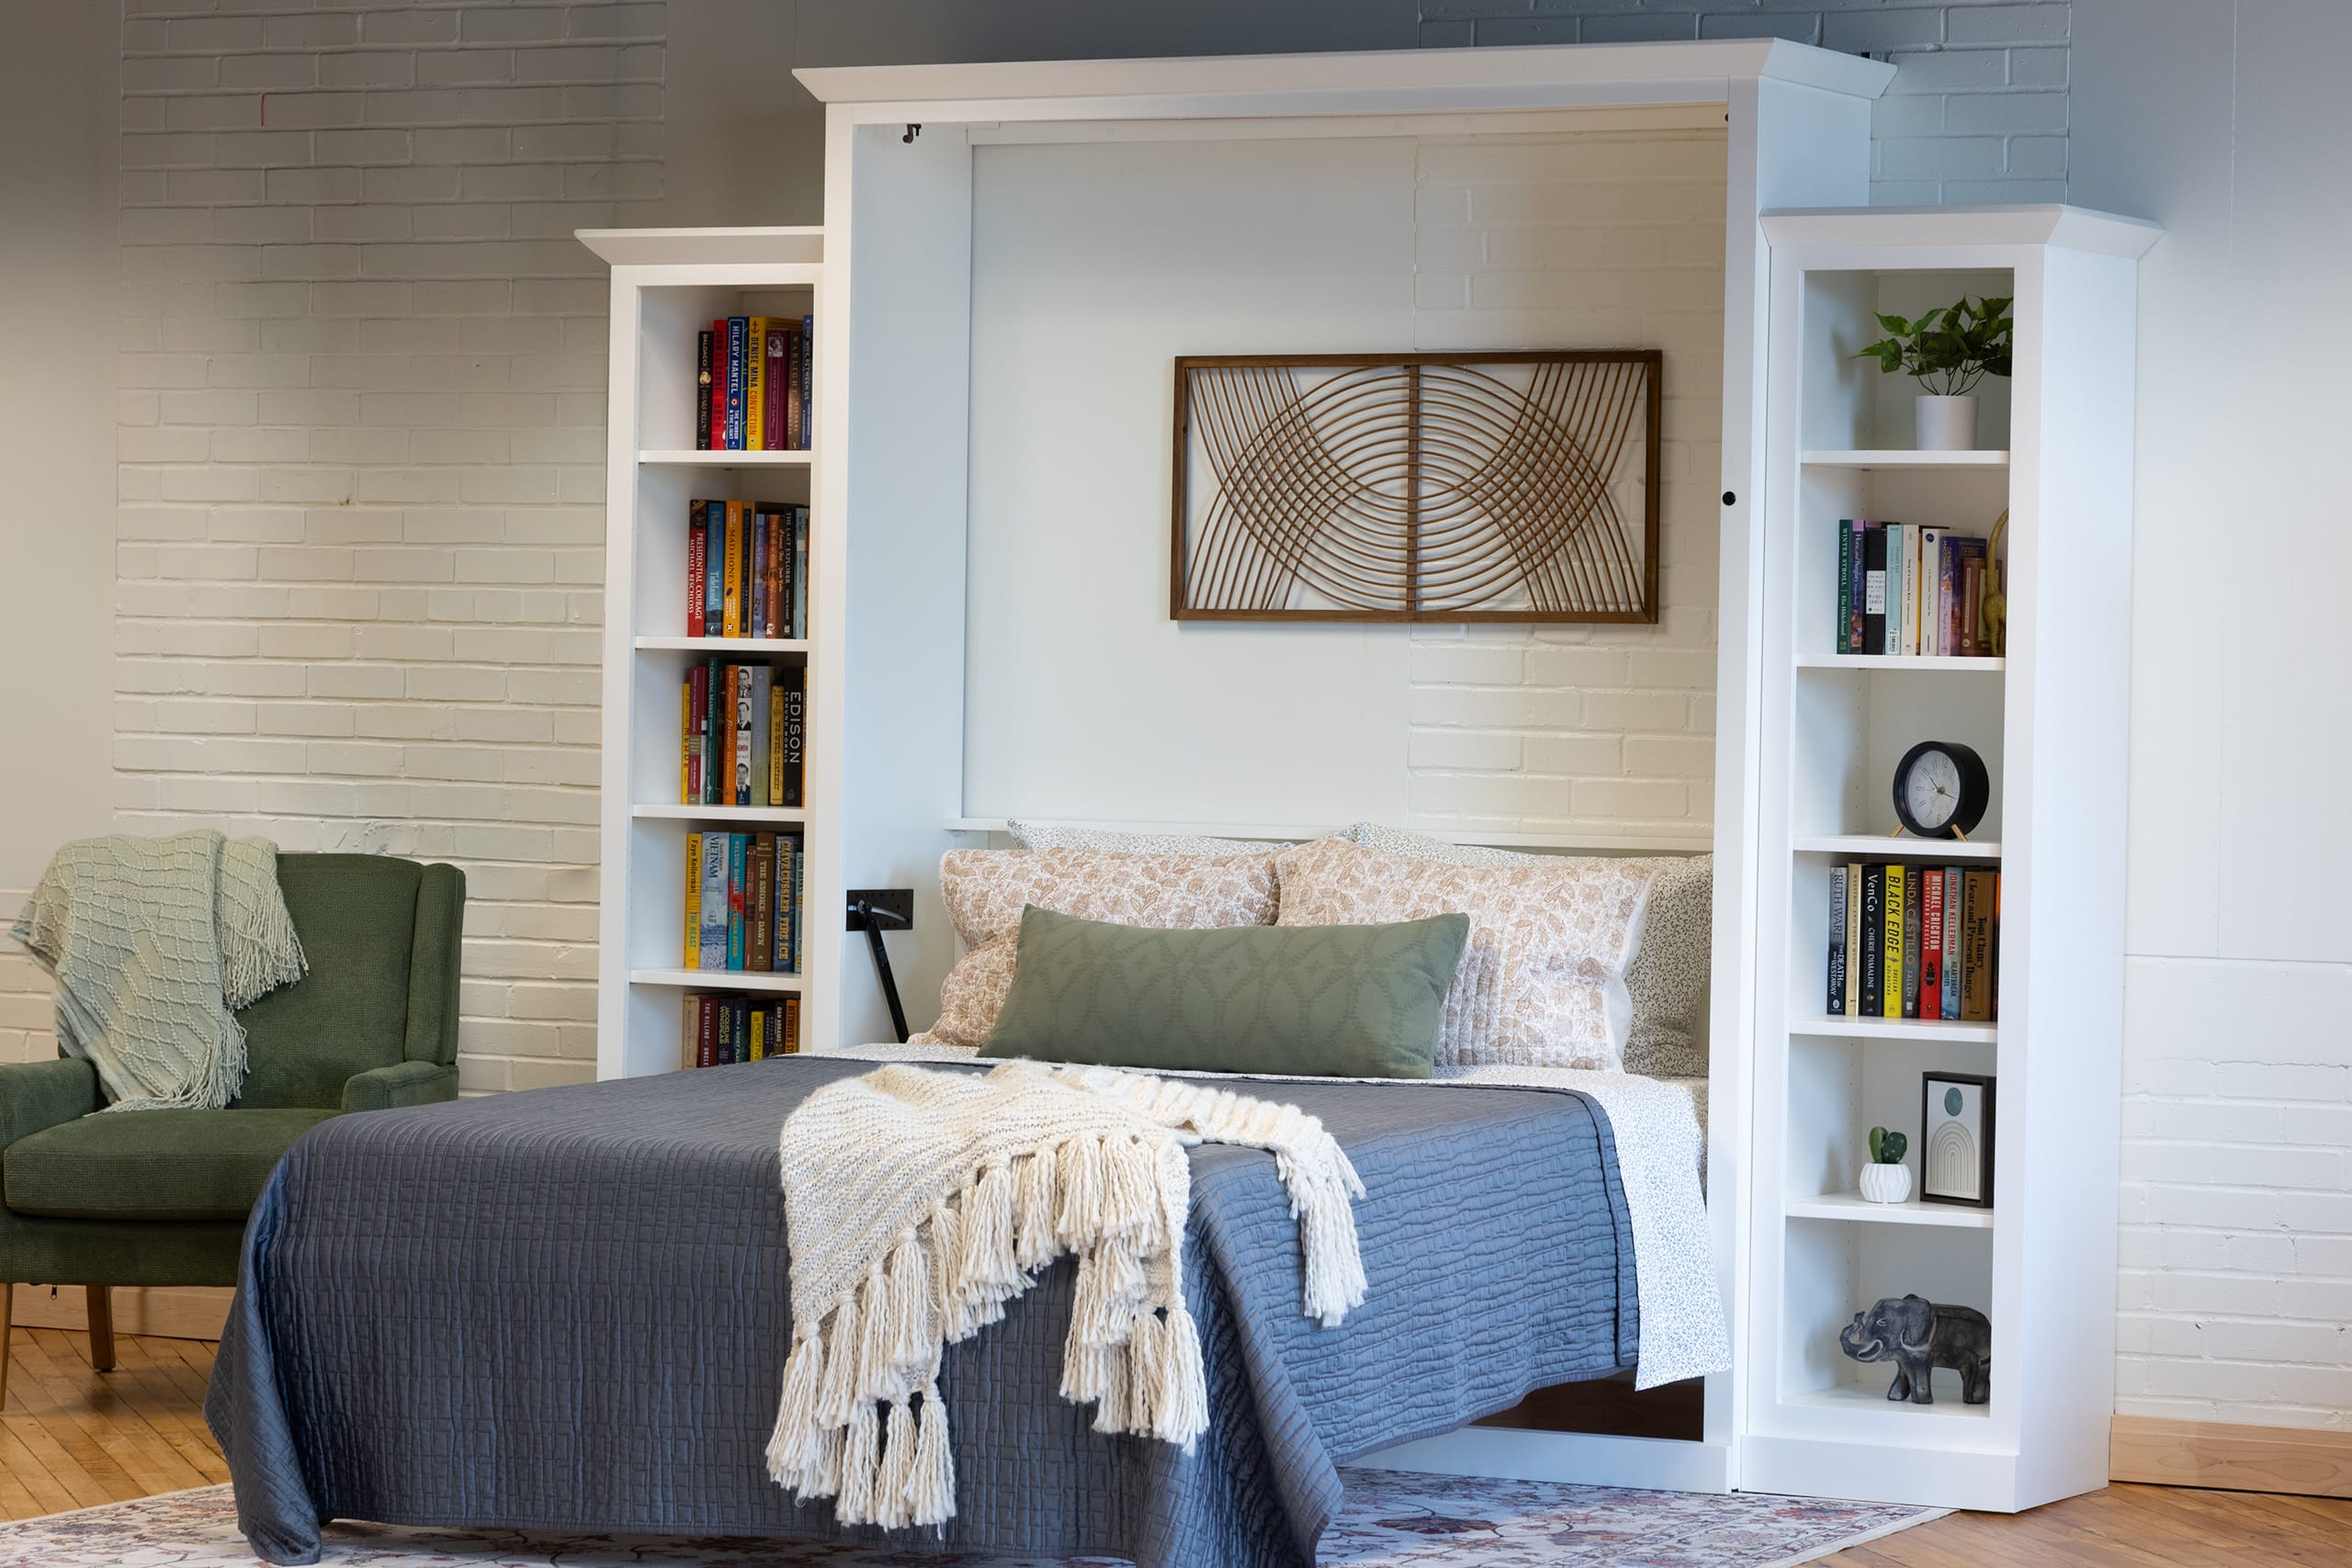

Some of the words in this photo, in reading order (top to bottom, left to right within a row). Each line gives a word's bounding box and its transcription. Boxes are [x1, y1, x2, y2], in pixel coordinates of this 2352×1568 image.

[731, 325, 740, 357] HILARY
[750, 336, 759, 364] DENISE
[730, 360, 739, 393] MANTEL
[750, 367, 759, 388] MINA
[749, 390, 757, 435] CONVICTION
[803, 391, 809, 400] US
[695, 533, 704, 582] PRESIDENTIAL
[695, 585, 703, 620] COURAGE
[709, 570, 719, 605] Tidelands
[789, 691, 801, 764] EDISON
[690, 840, 698, 856] Faye
[709, 836, 719, 878] VIETNAM
[781, 840, 791, 869] CLIVE
[690, 858, 698, 894] Kellerman
[779, 870, 790, 913] CUSSLER
[1834, 874, 1843, 904] RUTH
[1867, 874, 1878, 911] VenCo
[1906, 871, 1917, 906] LINDA
[1931, 876, 1941, 909] MICHAEL
[1948, 873, 1957, 909] JONATHAN
[1969, 878, 1977, 904] Clear
[1887, 876, 1900, 916] BLACK
[779, 917, 789, 941] FIRE
[1832, 908, 1843, 939] WARE
[1867, 928, 1875, 952] CHERIE
[1887, 920, 1900, 953] EDGE
[1905, 908, 1916, 964] CASTILLO
[1929, 911, 1940, 950] CRICHTON
[1948, 911, 1957, 955] KELLERMAN
[1977, 917, 1987, 935] Tom
[779, 942, 788, 960] ICE
[1966, 926, 1975, 964] Present
[1975, 938, 1986, 970] Clancy
[1837, 953, 1845, 980] DEATH
[1950, 961, 1958, 998] HEARTBREAK
[1964, 966, 1974, 1001] Danger
